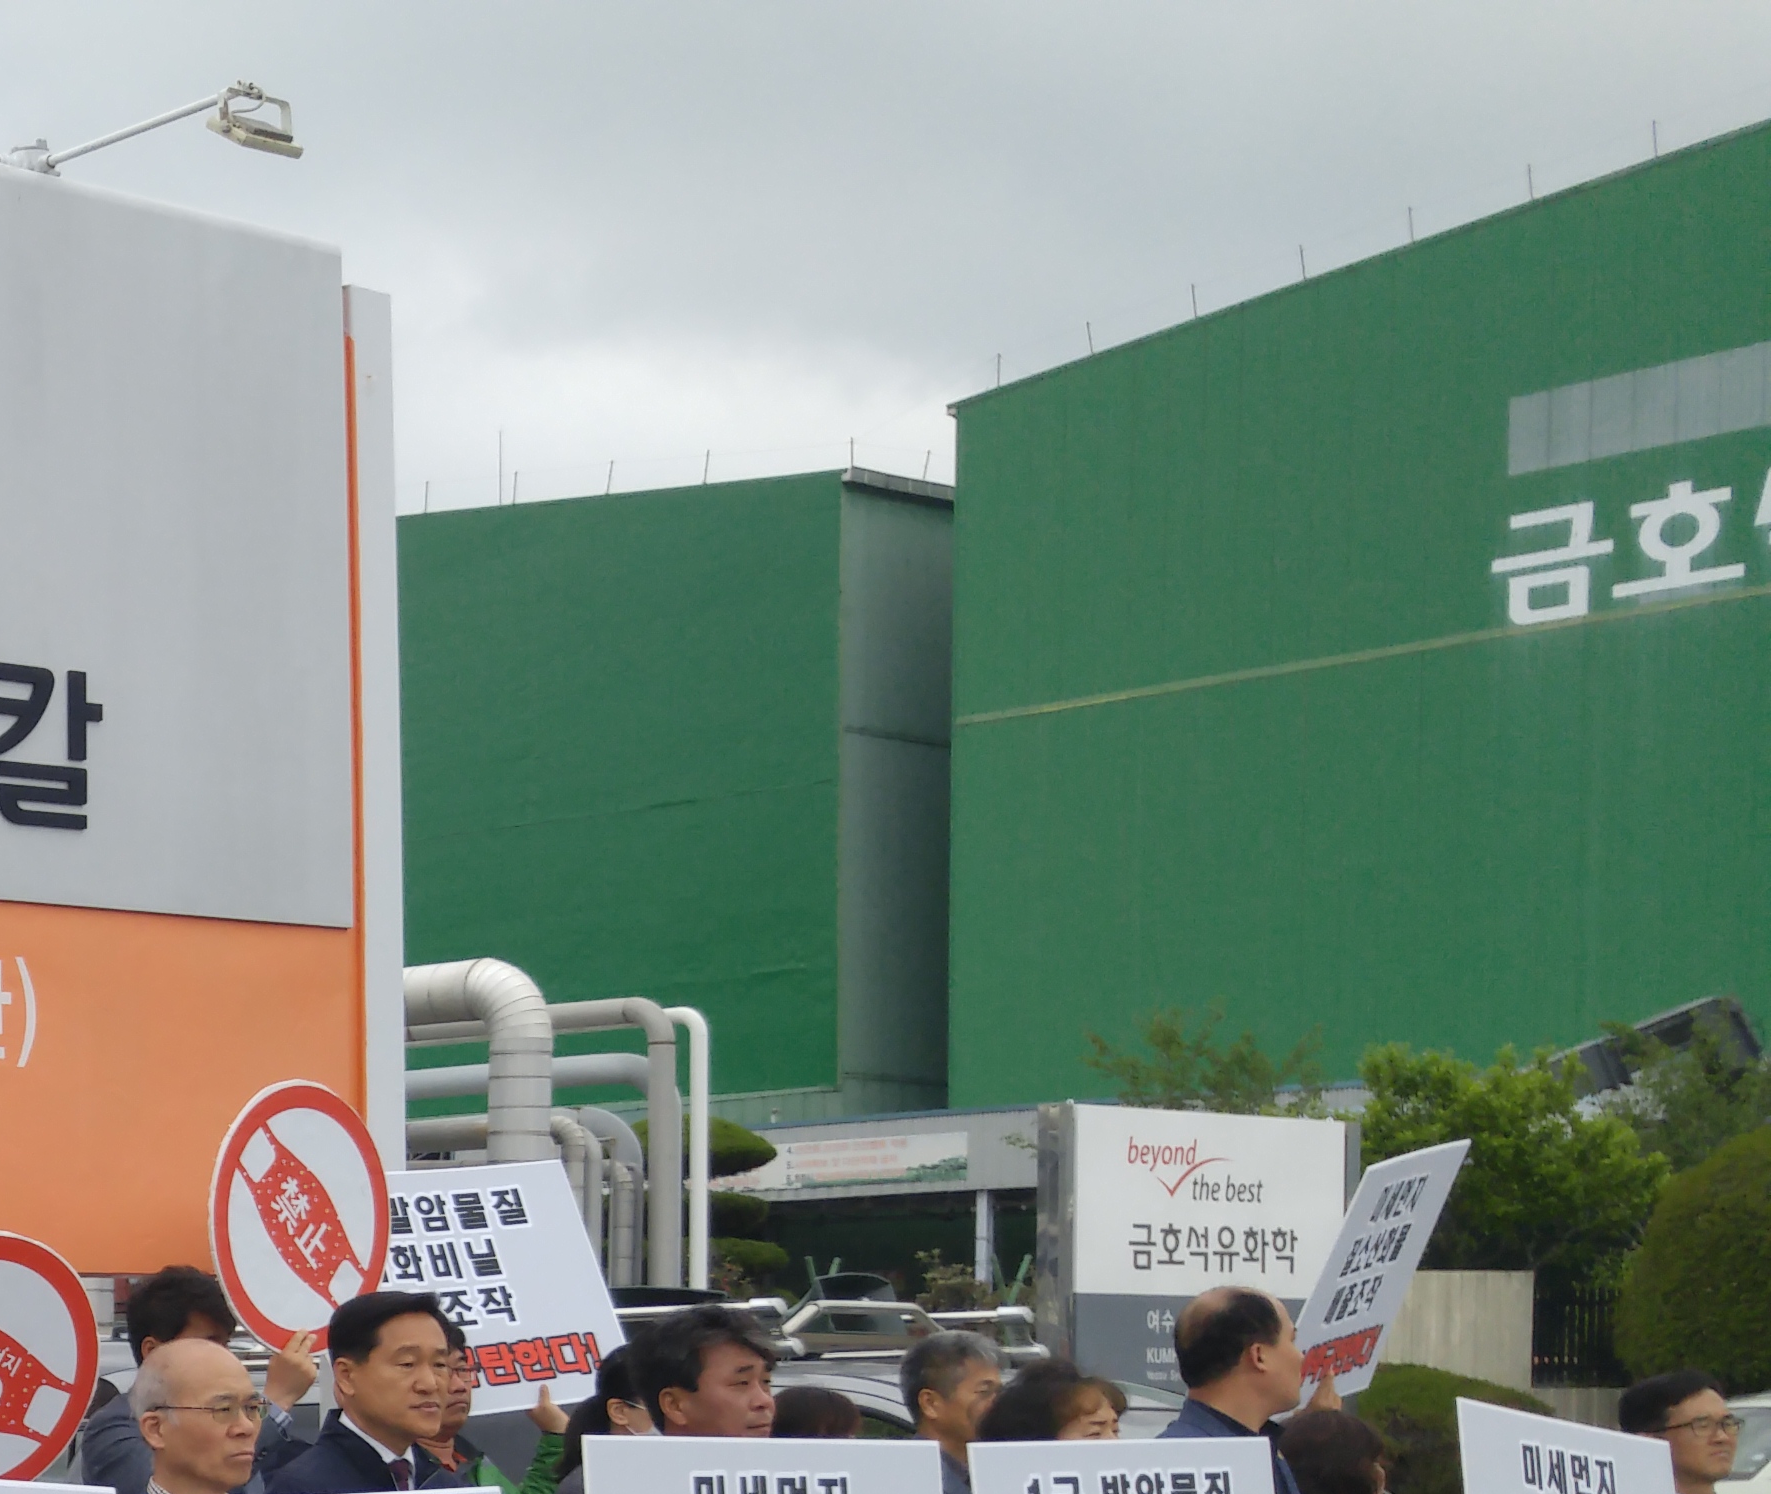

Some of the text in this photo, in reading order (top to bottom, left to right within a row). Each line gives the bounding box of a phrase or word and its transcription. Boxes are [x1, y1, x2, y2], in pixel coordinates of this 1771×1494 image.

[1491, 466, 1771, 625] 금호
[1127, 1136, 1197, 1171] beyond
[1192, 1174, 1264, 1203] the best
[270, 1176, 337, 1270] 禁止
[382, 1238, 502, 1283] 화비닐
[1129, 1223, 1298, 1275] 금호석유화학
[1146, 1309, 1175, 1334] 여수
